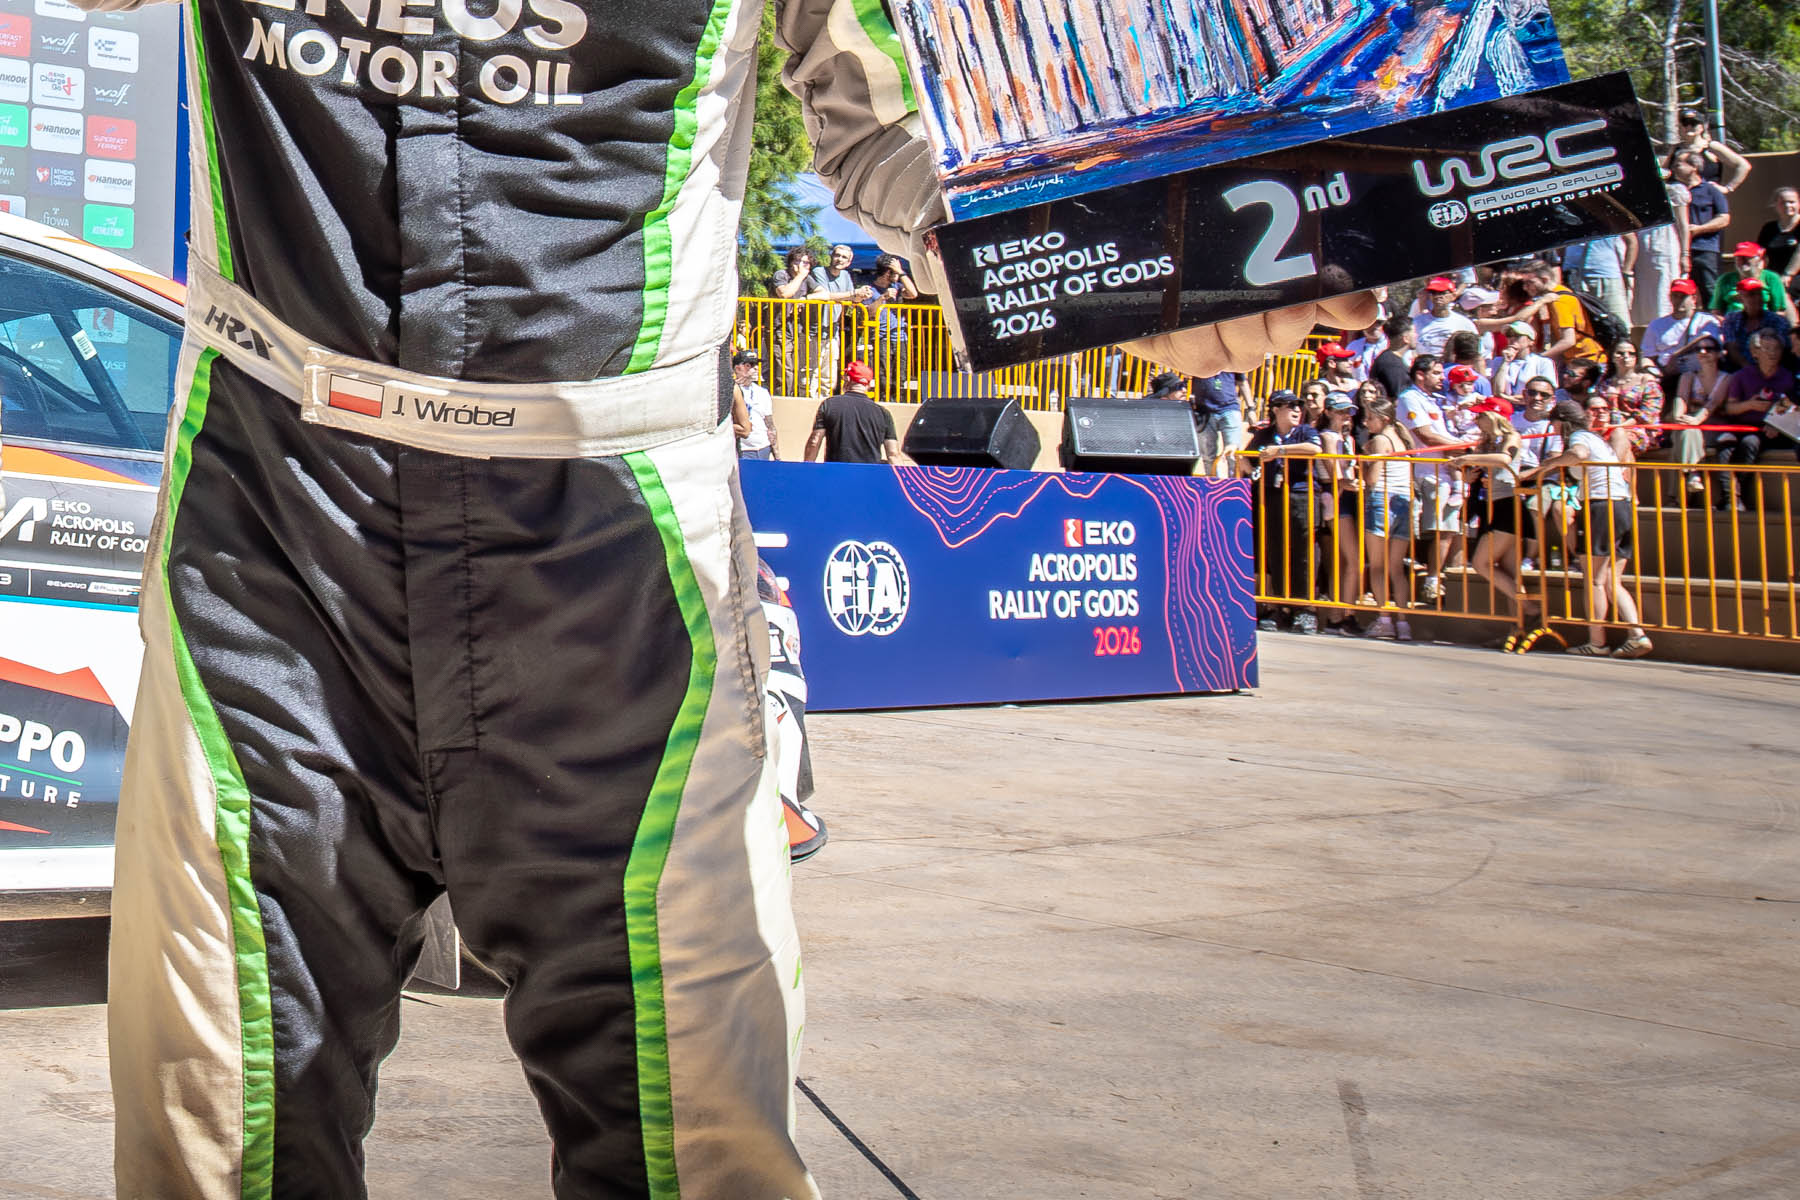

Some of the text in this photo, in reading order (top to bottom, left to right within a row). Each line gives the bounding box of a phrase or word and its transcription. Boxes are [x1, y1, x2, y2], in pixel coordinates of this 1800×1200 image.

[242, 17, 584, 106] MOTOR OIL
[1412, 118, 1618, 198] WRC
[1472, 167, 1619, 209] FIA WORLD RALLY
[1476, 181, 1623, 221] CHAMPIONSHIP
[1220, 170, 1352, 288] 2nd
[1431, 203, 1467, 227] FIA
[1002, 231, 1067, 260] EKO
[982, 242, 1120, 291] ACROPOLIS
[985, 254, 1176, 315] RALLY OF GODS
[203, 304, 275, 360] HRX
[992, 307, 1058, 340] 2026
[392, 395, 518, 428] J. Wróbel
[51, 499, 91, 513] EKO
[50, 531, 97, 548] RALLY
[97, 535, 119, 550] OF
[52, 514, 135, 535] ACROPOLIS
[1084, 520, 1136, 546] EKO
[1028, 552, 1137, 582] ACROPOLIS
[828, 560, 903, 617] FIA
[989, 588, 1140, 621] RALLY OF GODS
[1092, 626, 1143, 656] 2026
